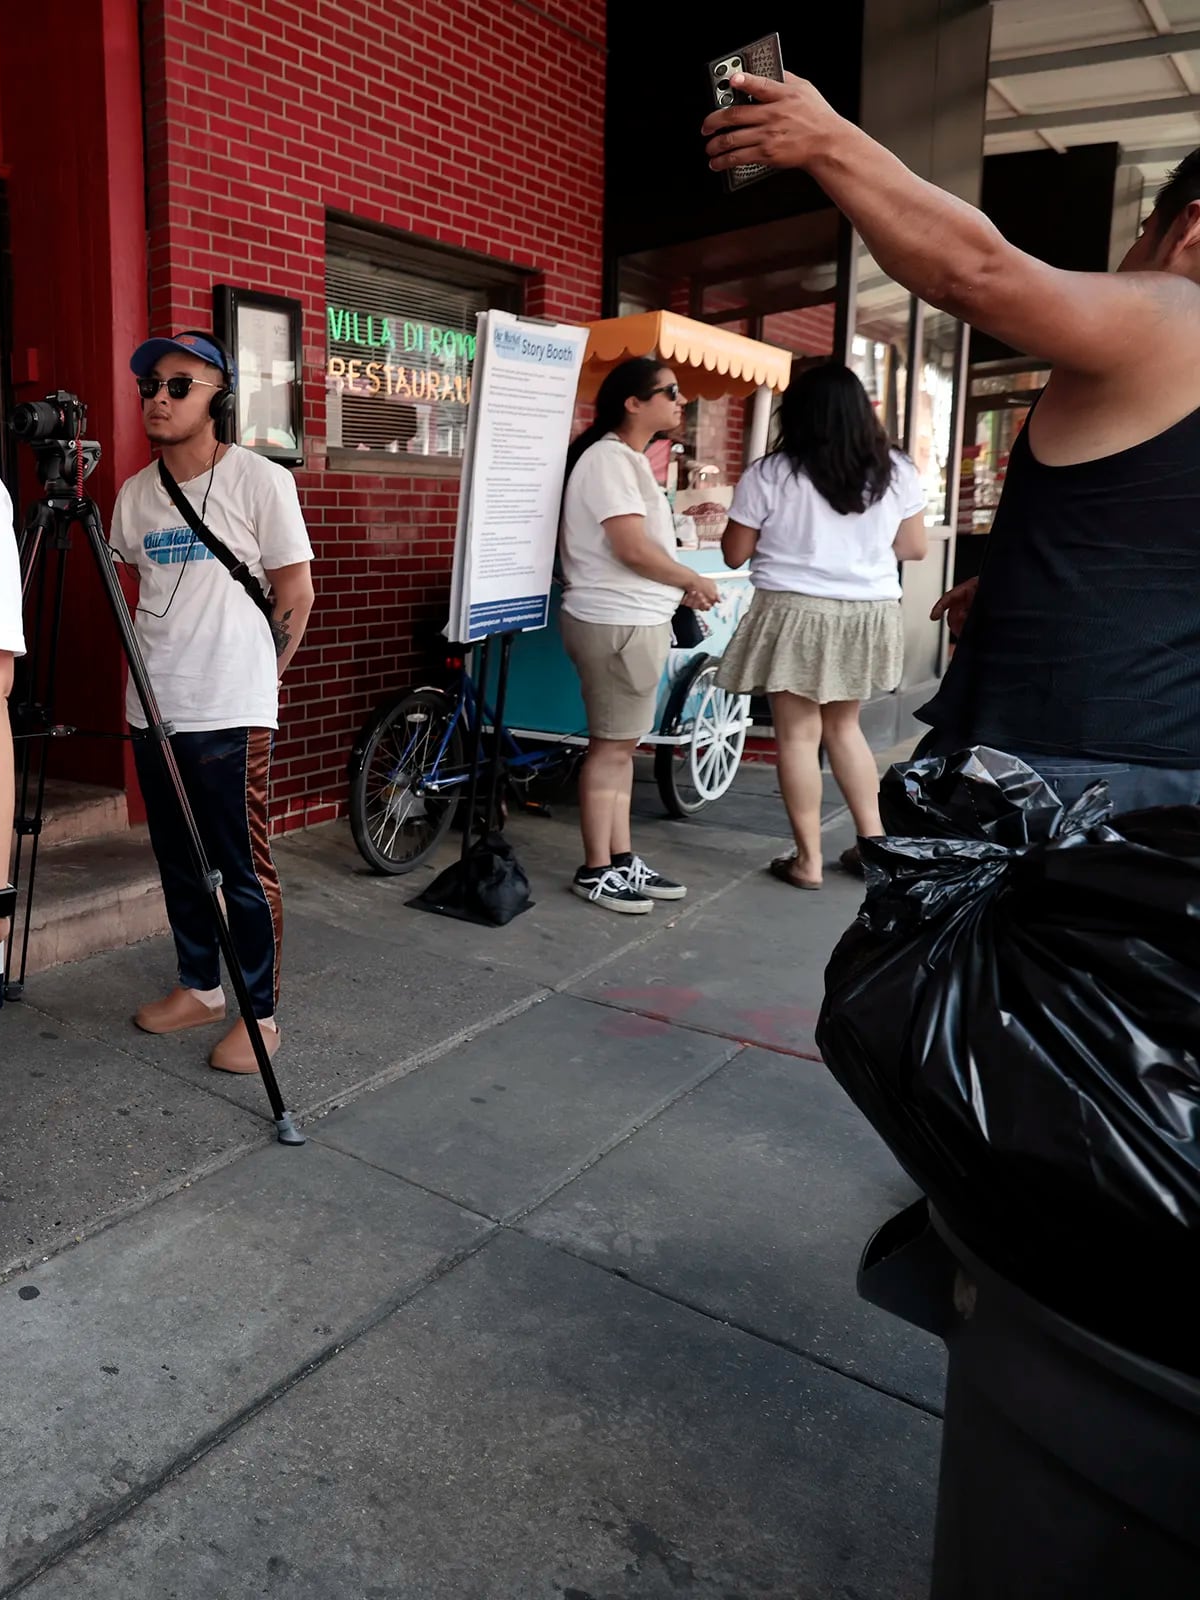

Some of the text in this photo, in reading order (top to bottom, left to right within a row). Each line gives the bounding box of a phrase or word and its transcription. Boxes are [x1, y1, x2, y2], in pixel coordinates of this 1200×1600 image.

[328, 307, 395, 348] VILLA
[404, 322, 424, 351] DI
[521, 339, 545, 361] Story
[547, 344, 573, 361] Booth
